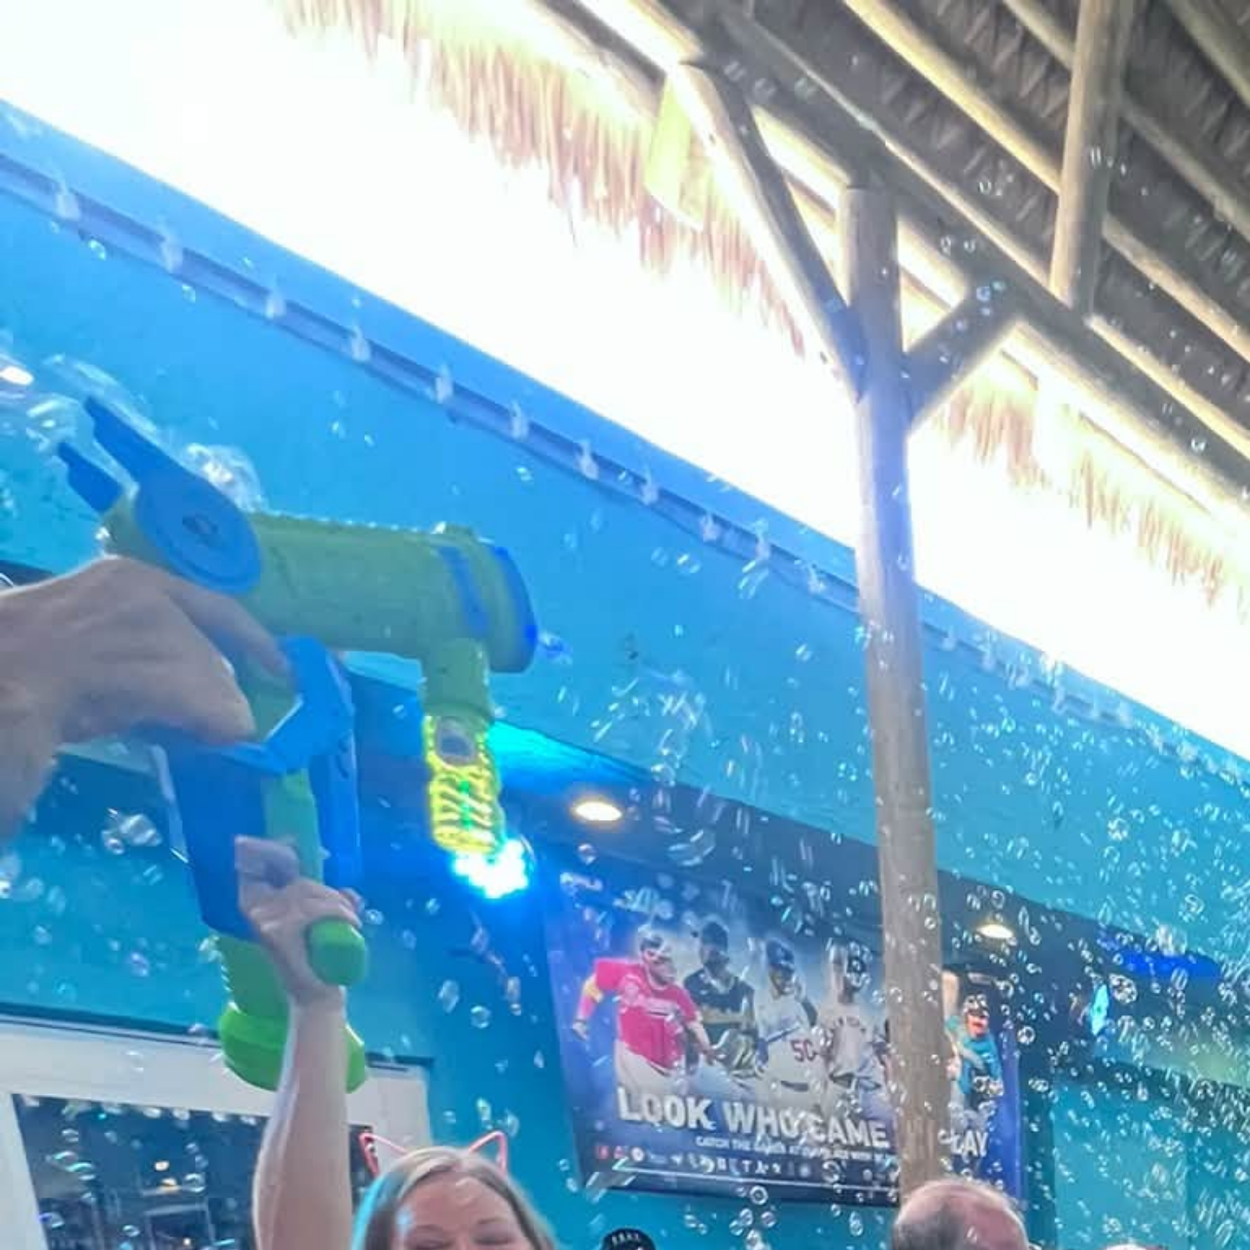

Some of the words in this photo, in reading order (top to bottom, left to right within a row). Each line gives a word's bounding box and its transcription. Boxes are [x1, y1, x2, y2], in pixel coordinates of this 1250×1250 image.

[617, 1086, 714, 1131] LOOK
[722, 1100, 801, 1138] WHO
[806, 1111, 891, 1148] CAME
